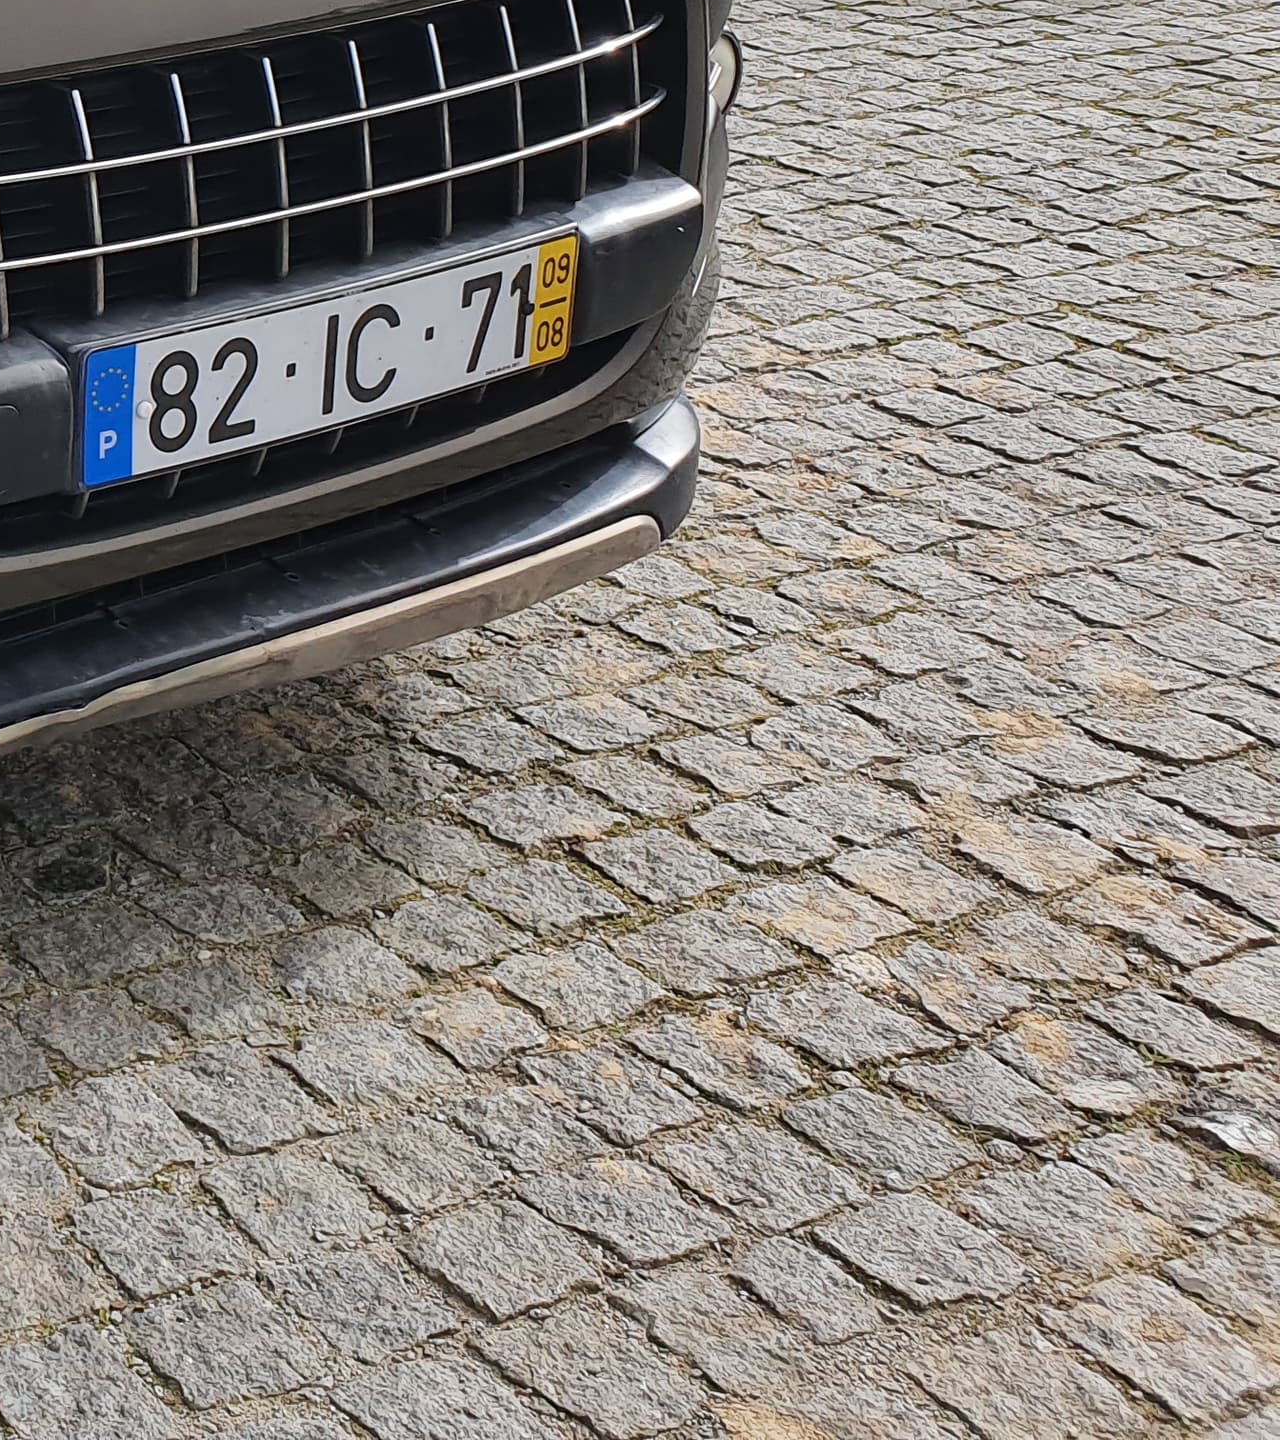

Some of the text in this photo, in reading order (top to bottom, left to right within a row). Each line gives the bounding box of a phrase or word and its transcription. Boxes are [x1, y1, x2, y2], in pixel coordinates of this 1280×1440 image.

[542, 253, 571, 288] 09
[536, 316, 565, 352] 08
[99, 429, 118, 460] P
